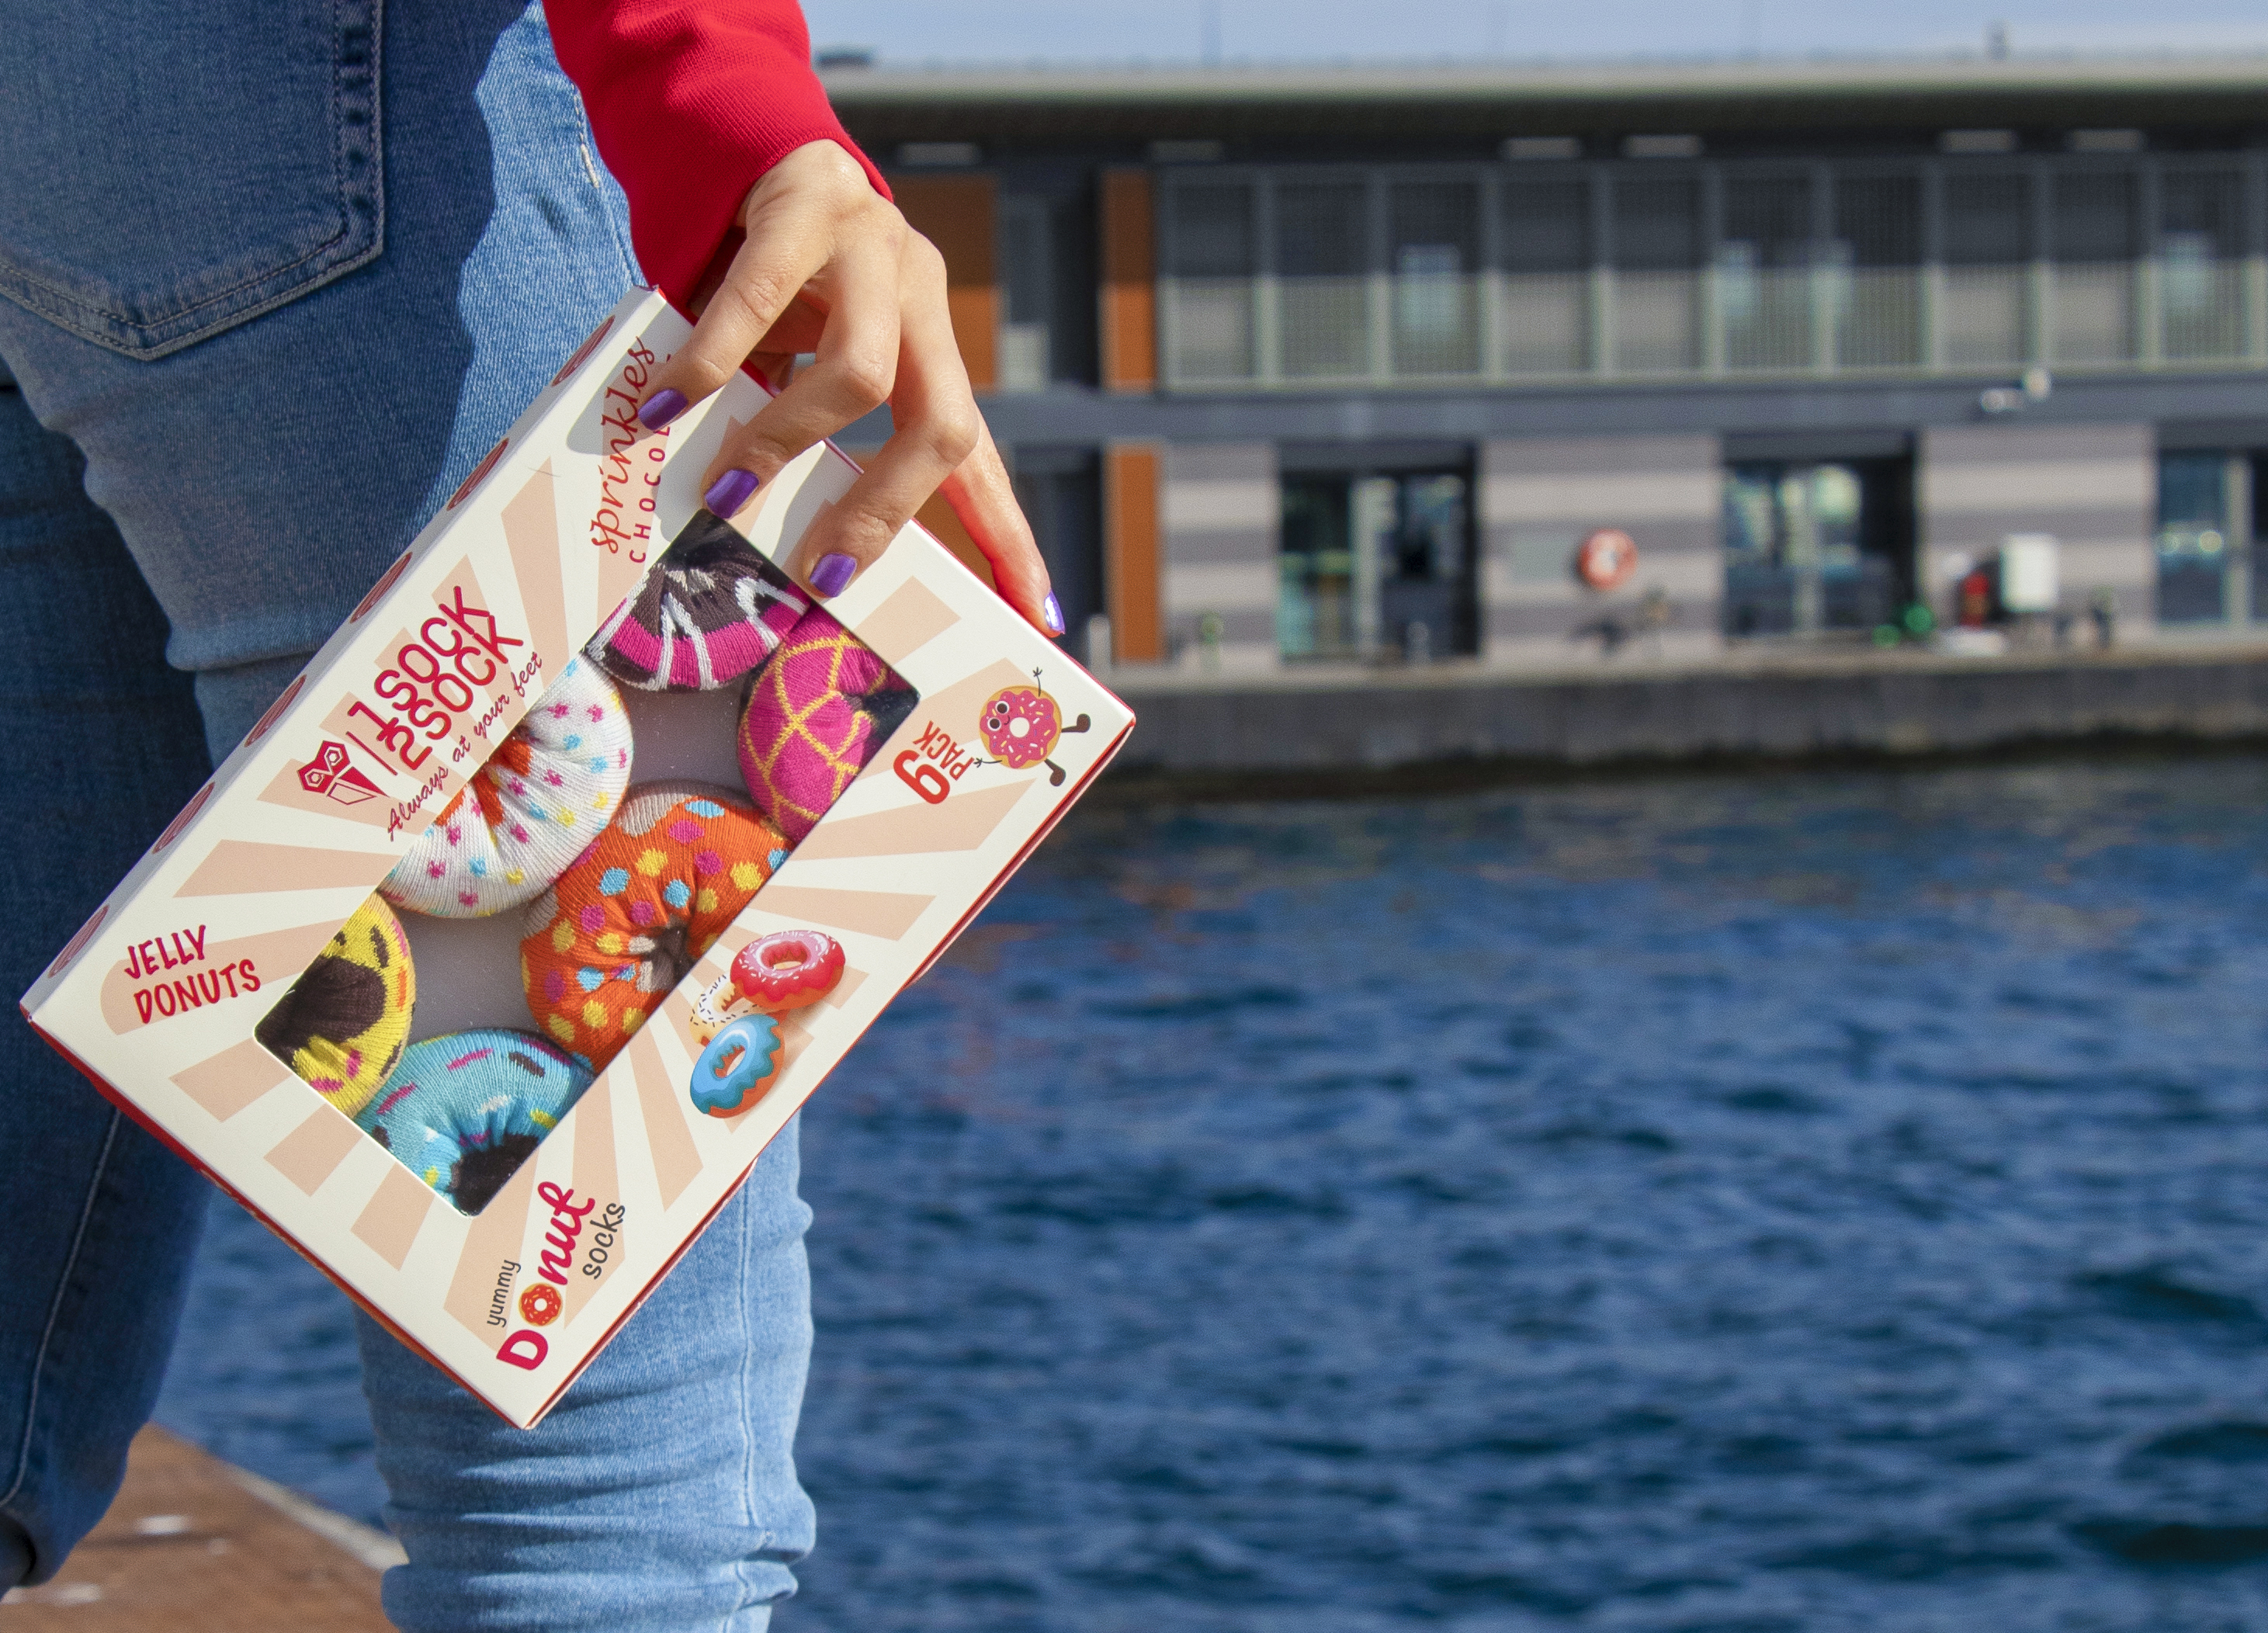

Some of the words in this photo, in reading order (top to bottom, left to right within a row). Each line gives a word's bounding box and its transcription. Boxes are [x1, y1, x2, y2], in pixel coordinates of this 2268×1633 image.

[589, 336, 655, 553] sprinkles
[629, 353, 671, 563] CHOCOL
[387, 764, 449, 841] Always
[453, 735, 470, 762] at
[473, 692, 510, 738] your
[510, 650, 543, 698] feet
[893, 749, 951, 805] 6
[913, 719, 975, 781] PACK
[123, 924, 206, 979] JELLY
[134, 959, 261, 1024] DONUTS
[582, 1202, 626, 1280] socks
[487, 1260, 522, 1328] yummy
